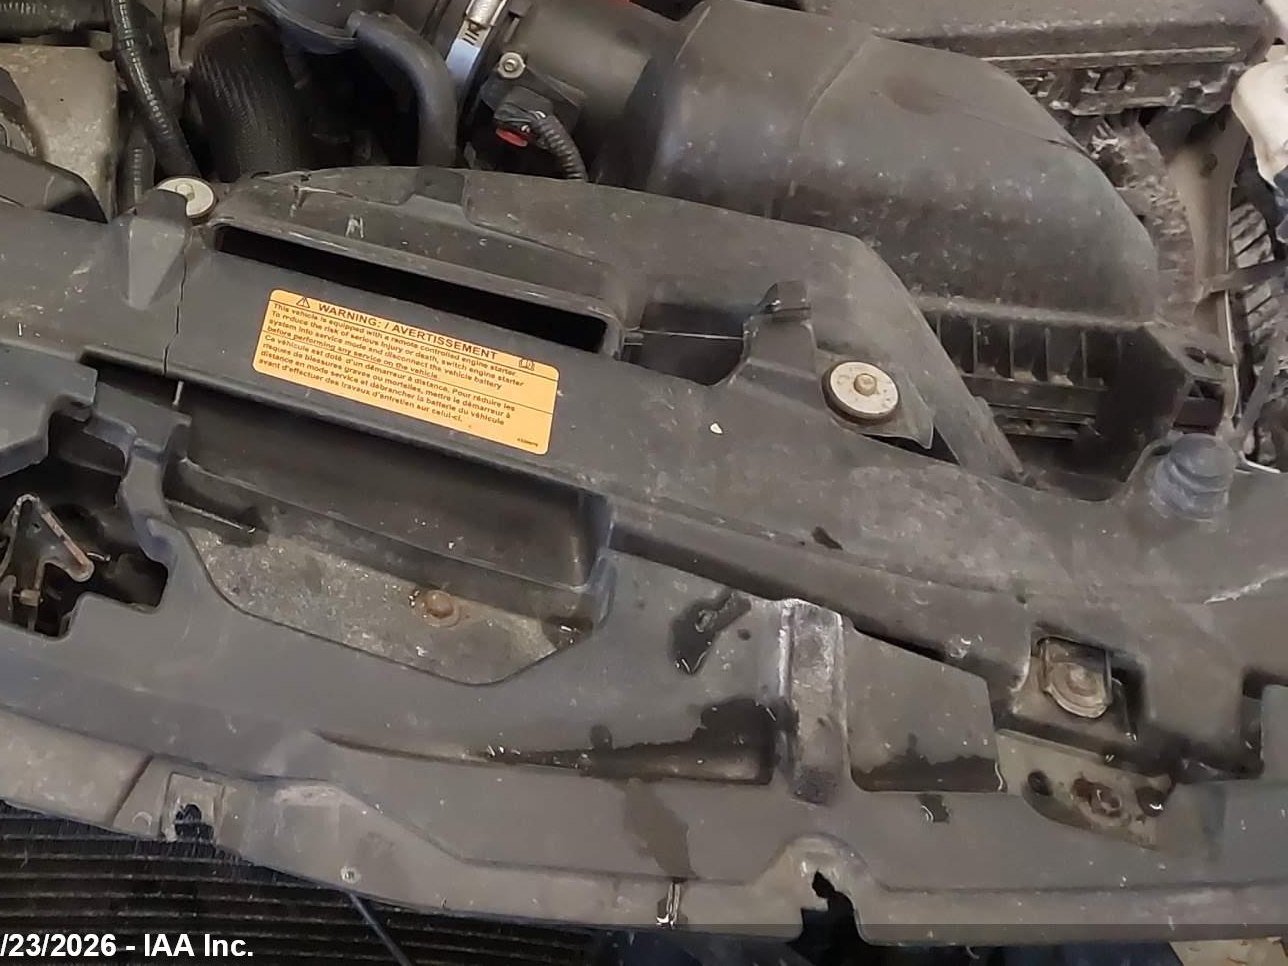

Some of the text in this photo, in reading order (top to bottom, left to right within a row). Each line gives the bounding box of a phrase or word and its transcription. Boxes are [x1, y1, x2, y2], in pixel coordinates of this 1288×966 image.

[266, 325, 292, 337] before
[292, 332, 336, 351] performing
[336, 346, 351, 356] any
[352, 349, 382, 363] service
[382, 358, 393, 366] on
[394, 361, 408, 370] the
[267, 317, 297, 332] system
[297, 326, 314, 336] into
[314, 330, 342, 344] service
[343, 339, 366, 350] mode
[367, 345, 383, 355] and
[429, 362, 442, 372] the
[443, 367, 472, 380] vehicle
[473, 375, 502, 390] battery
[271, 310, 281, 318] To
[309, 321, 322, 330] the
[323, 325, 338, 334] risk
[340, 329, 349, 337] of
[349, 332, 379, 346] serious
[379, 341, 403, 354] injury
[414, 350, 439, 365] death,
[441, 358, 467, 370] switch
[468, 365, 495, 380] engine
[497, 374, 524, 387] starter
[272, 302, 289, 312] This
[290, 308, 318, 320] vehicle
[327, 318, 364, 335] equipped
[365, 328, 383, 339] with
[390, 336, 418, 349] remote
[419, 344, 460, 360] controlled
[460, 355, 488, 370] engine
[317, 304, 381, 328] WARNING:
[390, 324, 498, 360] AVERTISSEMENT
[258, 358, 280, 369] avant
[324, 376, 339, 386] des
[340, 381, 370, 395] travaux
[415, 404, 429, 412] sur
[260, 349, 294, 364] distance
[294, 360, 305, 368] en
[306, 362, 329, 375] mode
[329, 369, 358, 383] service
[359, 378, 368, 386] et
[416, 394, 425, 402] la
[425, 397, 456, 412] batterie
[457, 406, 469, 415] du
[261, 342, 291, 357] risques
[292, 350, 303, 359] de
[304, 354, 342, 370] blessures
[343, 366, 370, 380] graves
[373, 374, 383, 382] ou
[425, 389, 451, 401] mettre
[452, 396, 460, 404] le
[264, 334, 276, 343] Ce
[310, 348, 323, 356] est
[451, 387, 471, 399] Pour
[503, 402, 515, 412] les
